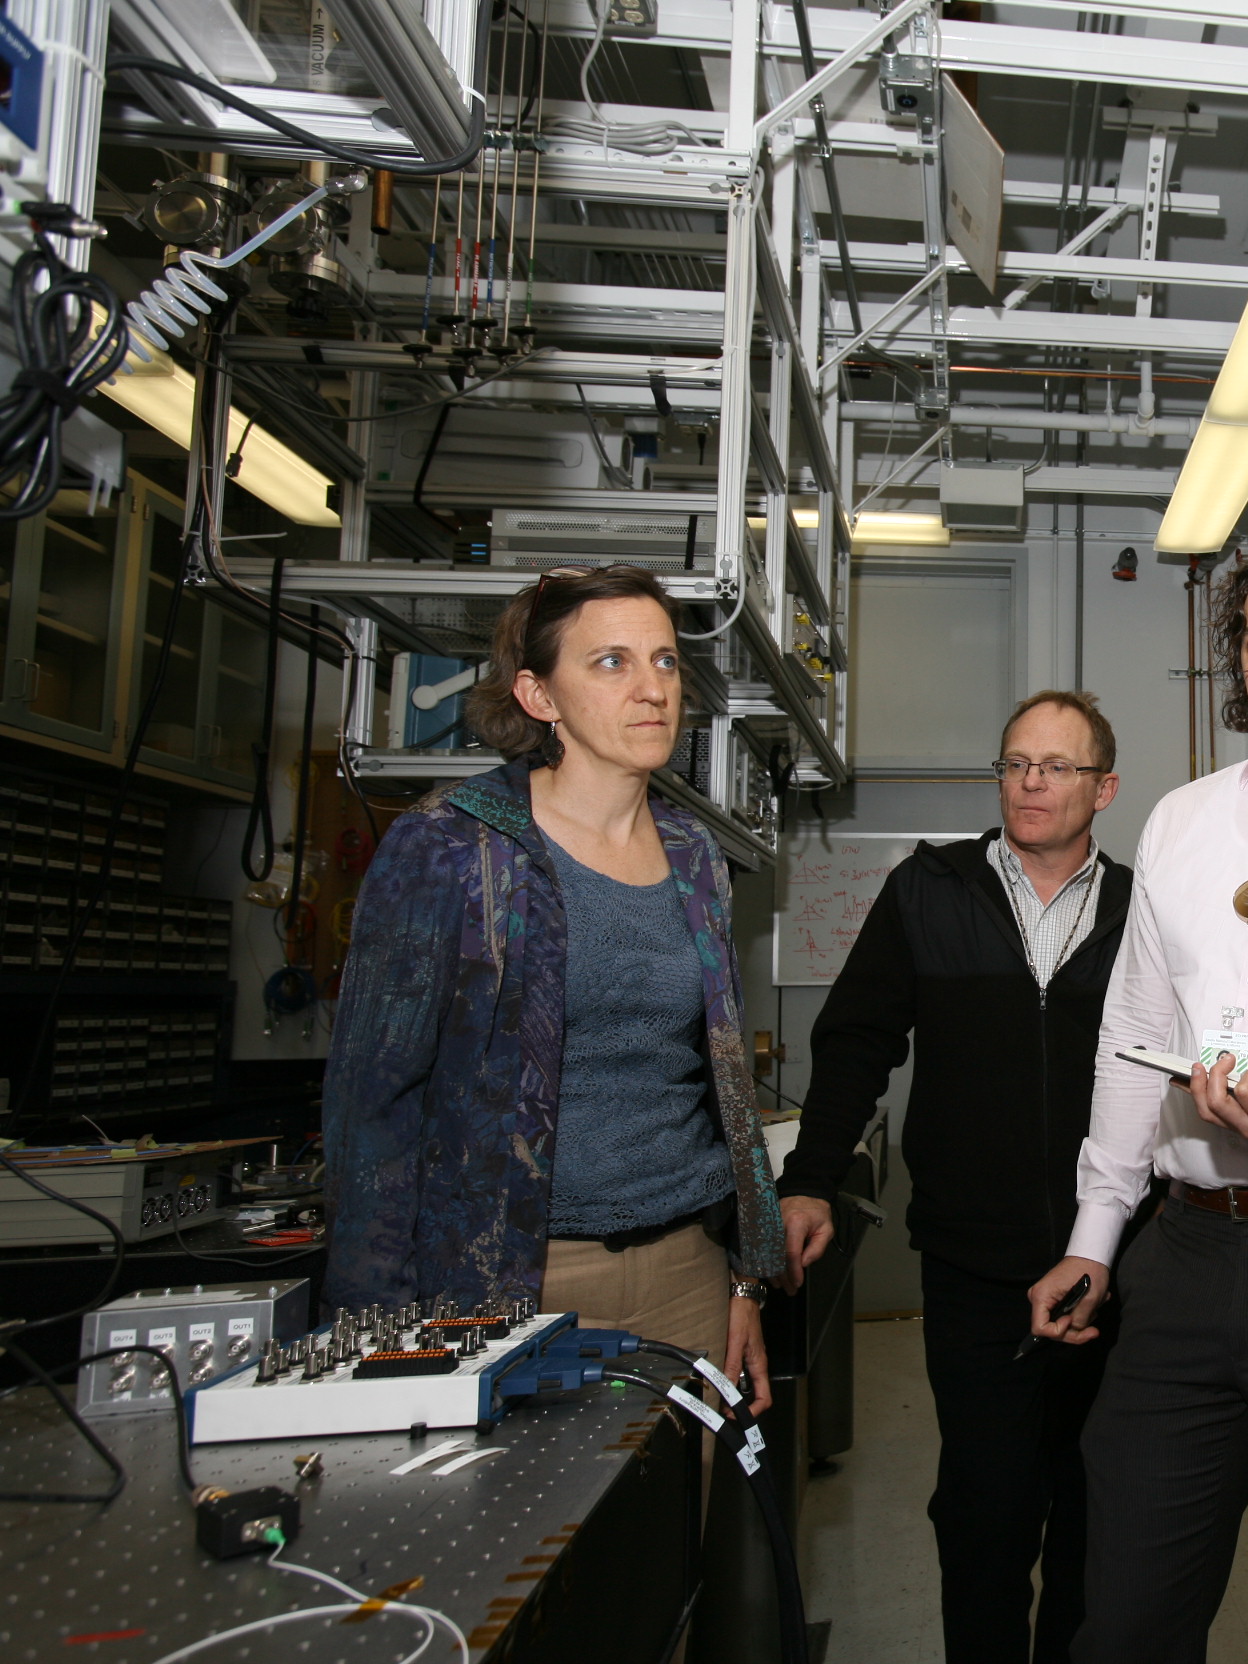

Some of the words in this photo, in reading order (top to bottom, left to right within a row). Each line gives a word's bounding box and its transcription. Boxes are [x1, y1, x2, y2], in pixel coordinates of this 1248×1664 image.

[311, 24, 325, 76] VACUUM
[113, 1335, 134, 1343] OUT4
[153, 1332, 174, 1340] OUT3
